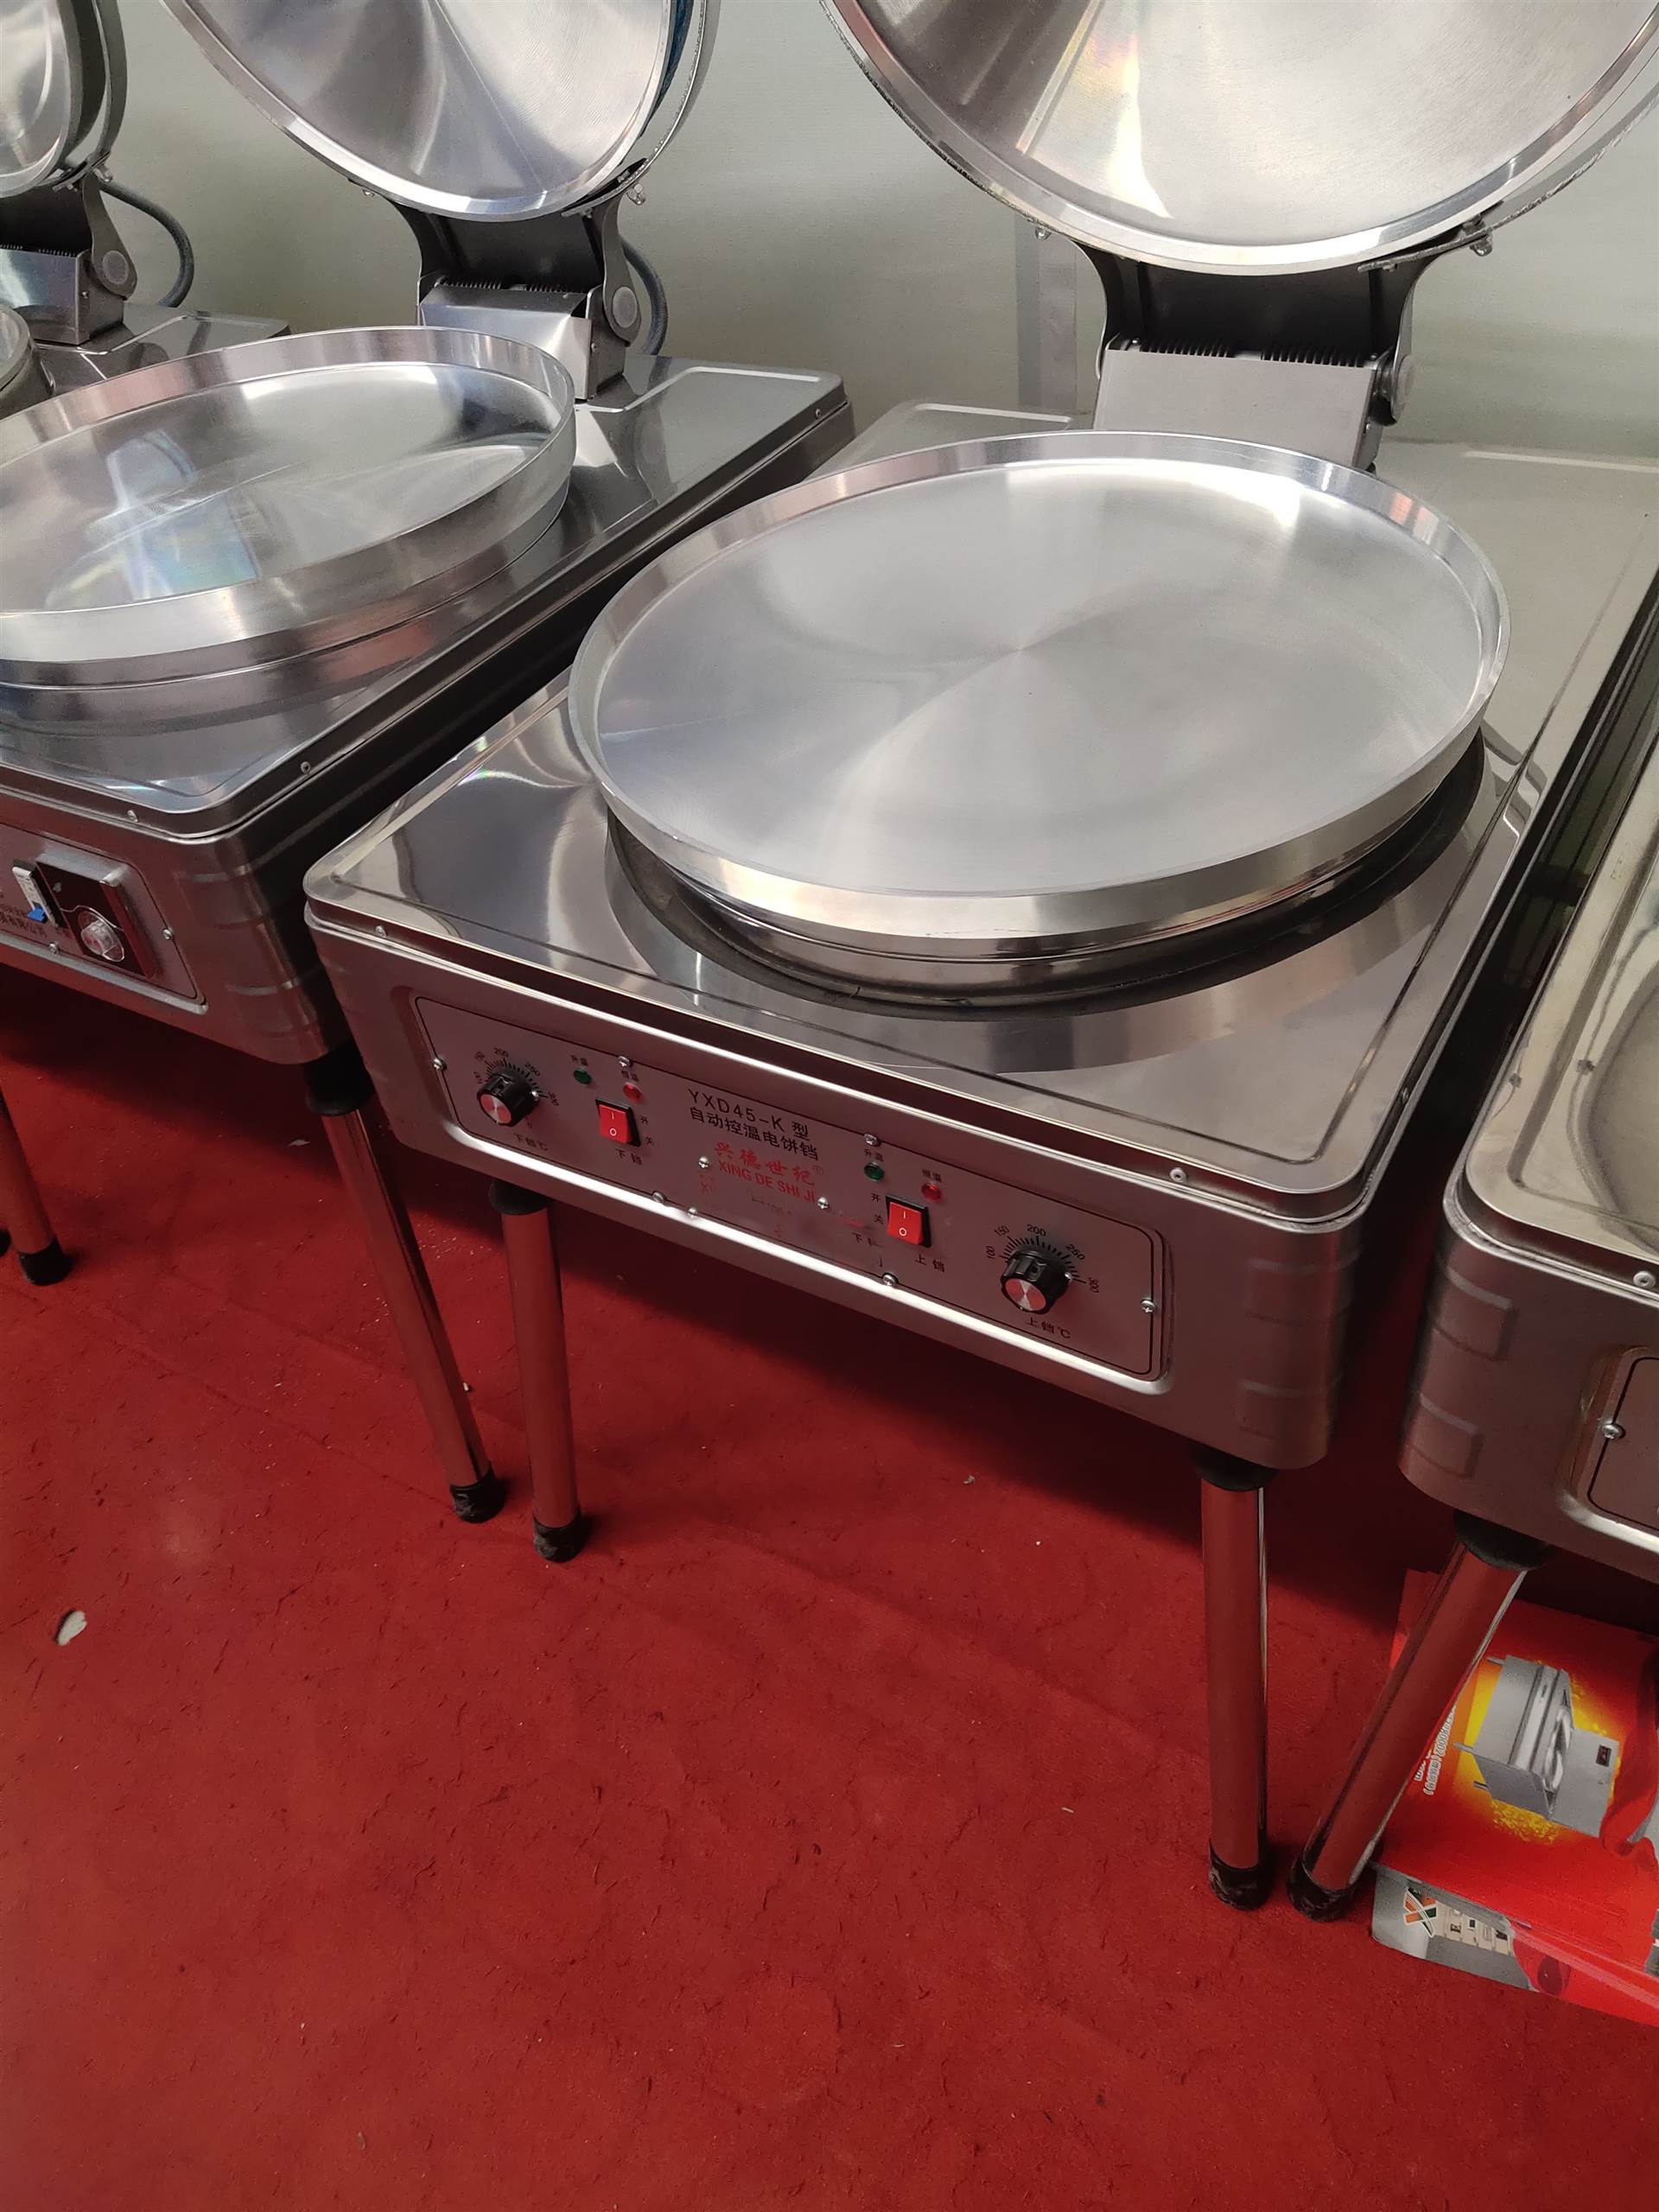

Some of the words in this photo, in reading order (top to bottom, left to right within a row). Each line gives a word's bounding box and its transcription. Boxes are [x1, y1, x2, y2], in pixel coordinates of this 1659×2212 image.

[688, 1088, 785, 1132] YXD45-K
[791, 1121, 810, 1141] 型
[690, 1106, 819, 1162] 自动控温电饼铛
[718, 1160, 753, 1182] XING
[755, 1173, 773, 1188] DE
[778, 1180, 800, 1198] SHI
[804, 1191, 816, 1204] JI
[1027, 1224, 1046, 1236] 200
